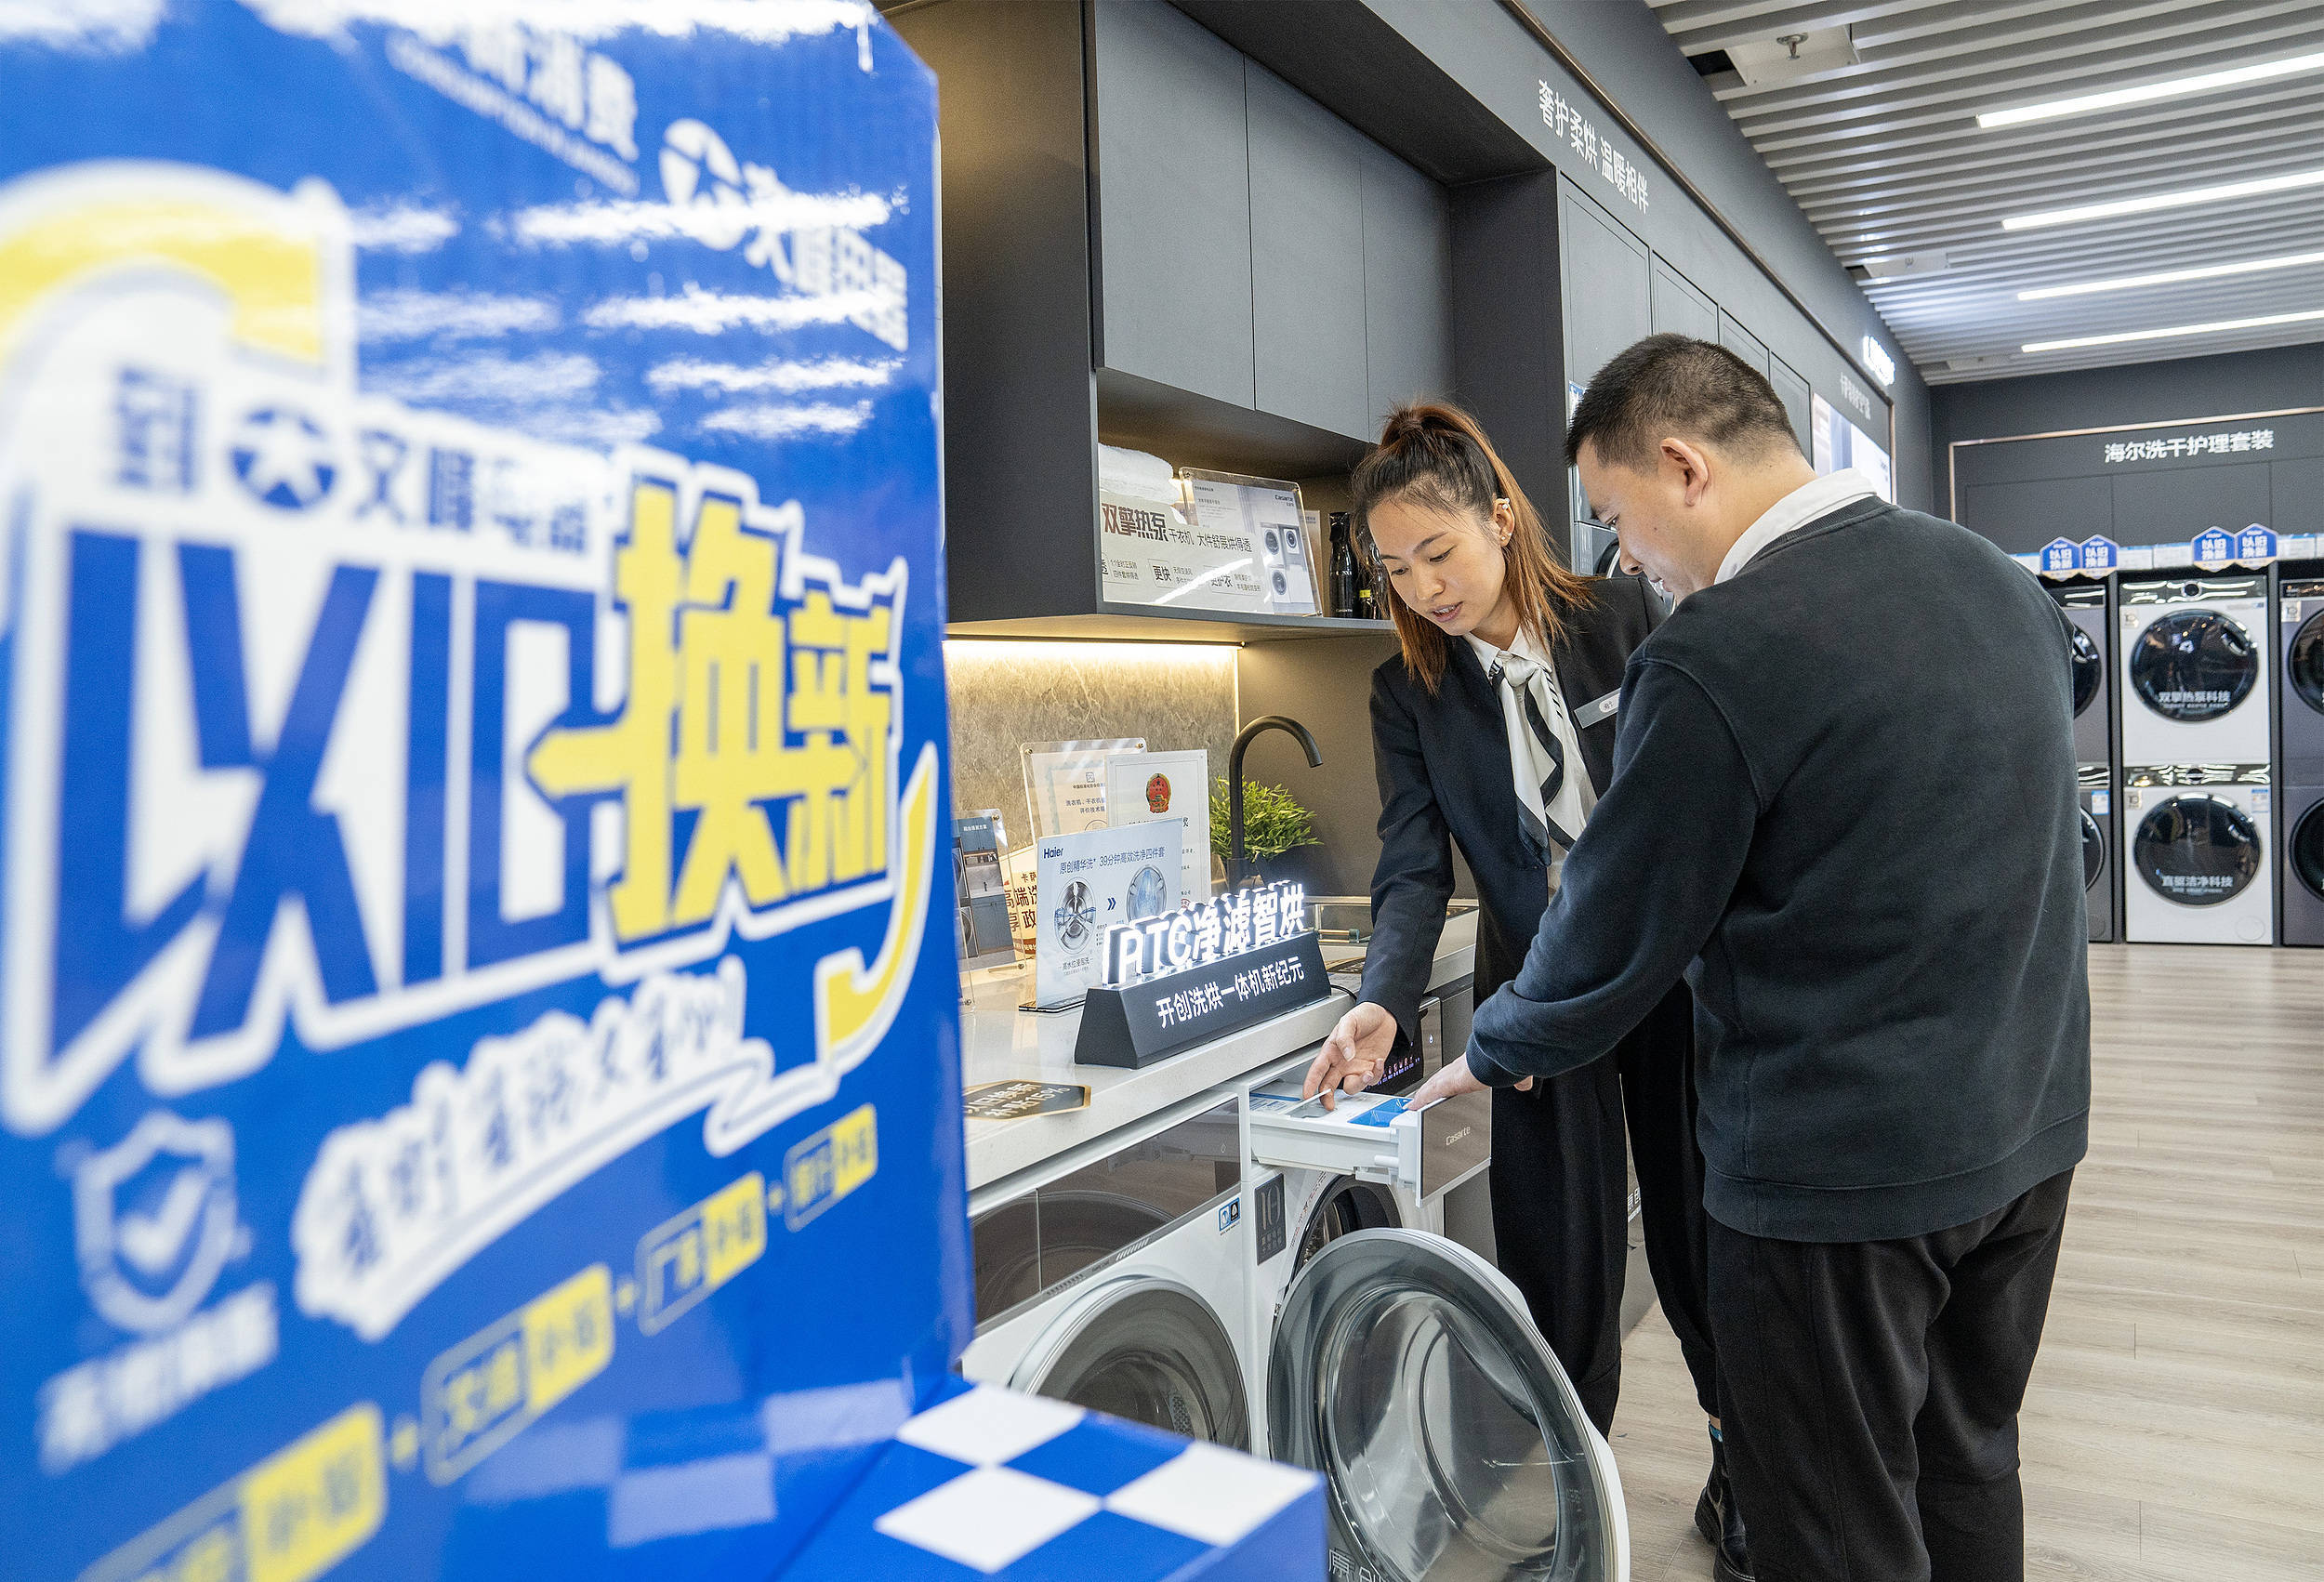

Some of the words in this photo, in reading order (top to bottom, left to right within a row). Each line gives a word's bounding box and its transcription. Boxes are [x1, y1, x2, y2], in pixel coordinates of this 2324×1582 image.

[1538, 79, 1598, 171] 奢护柔烘
[1600, 137, 1649, 215] 温暖相伴
[2104, 429, 2274, 463] 海尔洗干护理套装
[1153, 565, 1171, 581] 更快
[1043, 846, 1063, 859] Haier
[1100, 846, 1165, 867] 39分钟高效洗净四件套
[1106, 881, 1305, 985] PTC净滤智烘
[1155, 956, 1305, 1029] 开创洗烘一体机新纪元
[1446, 1126, 1472, 1146] Casarte
